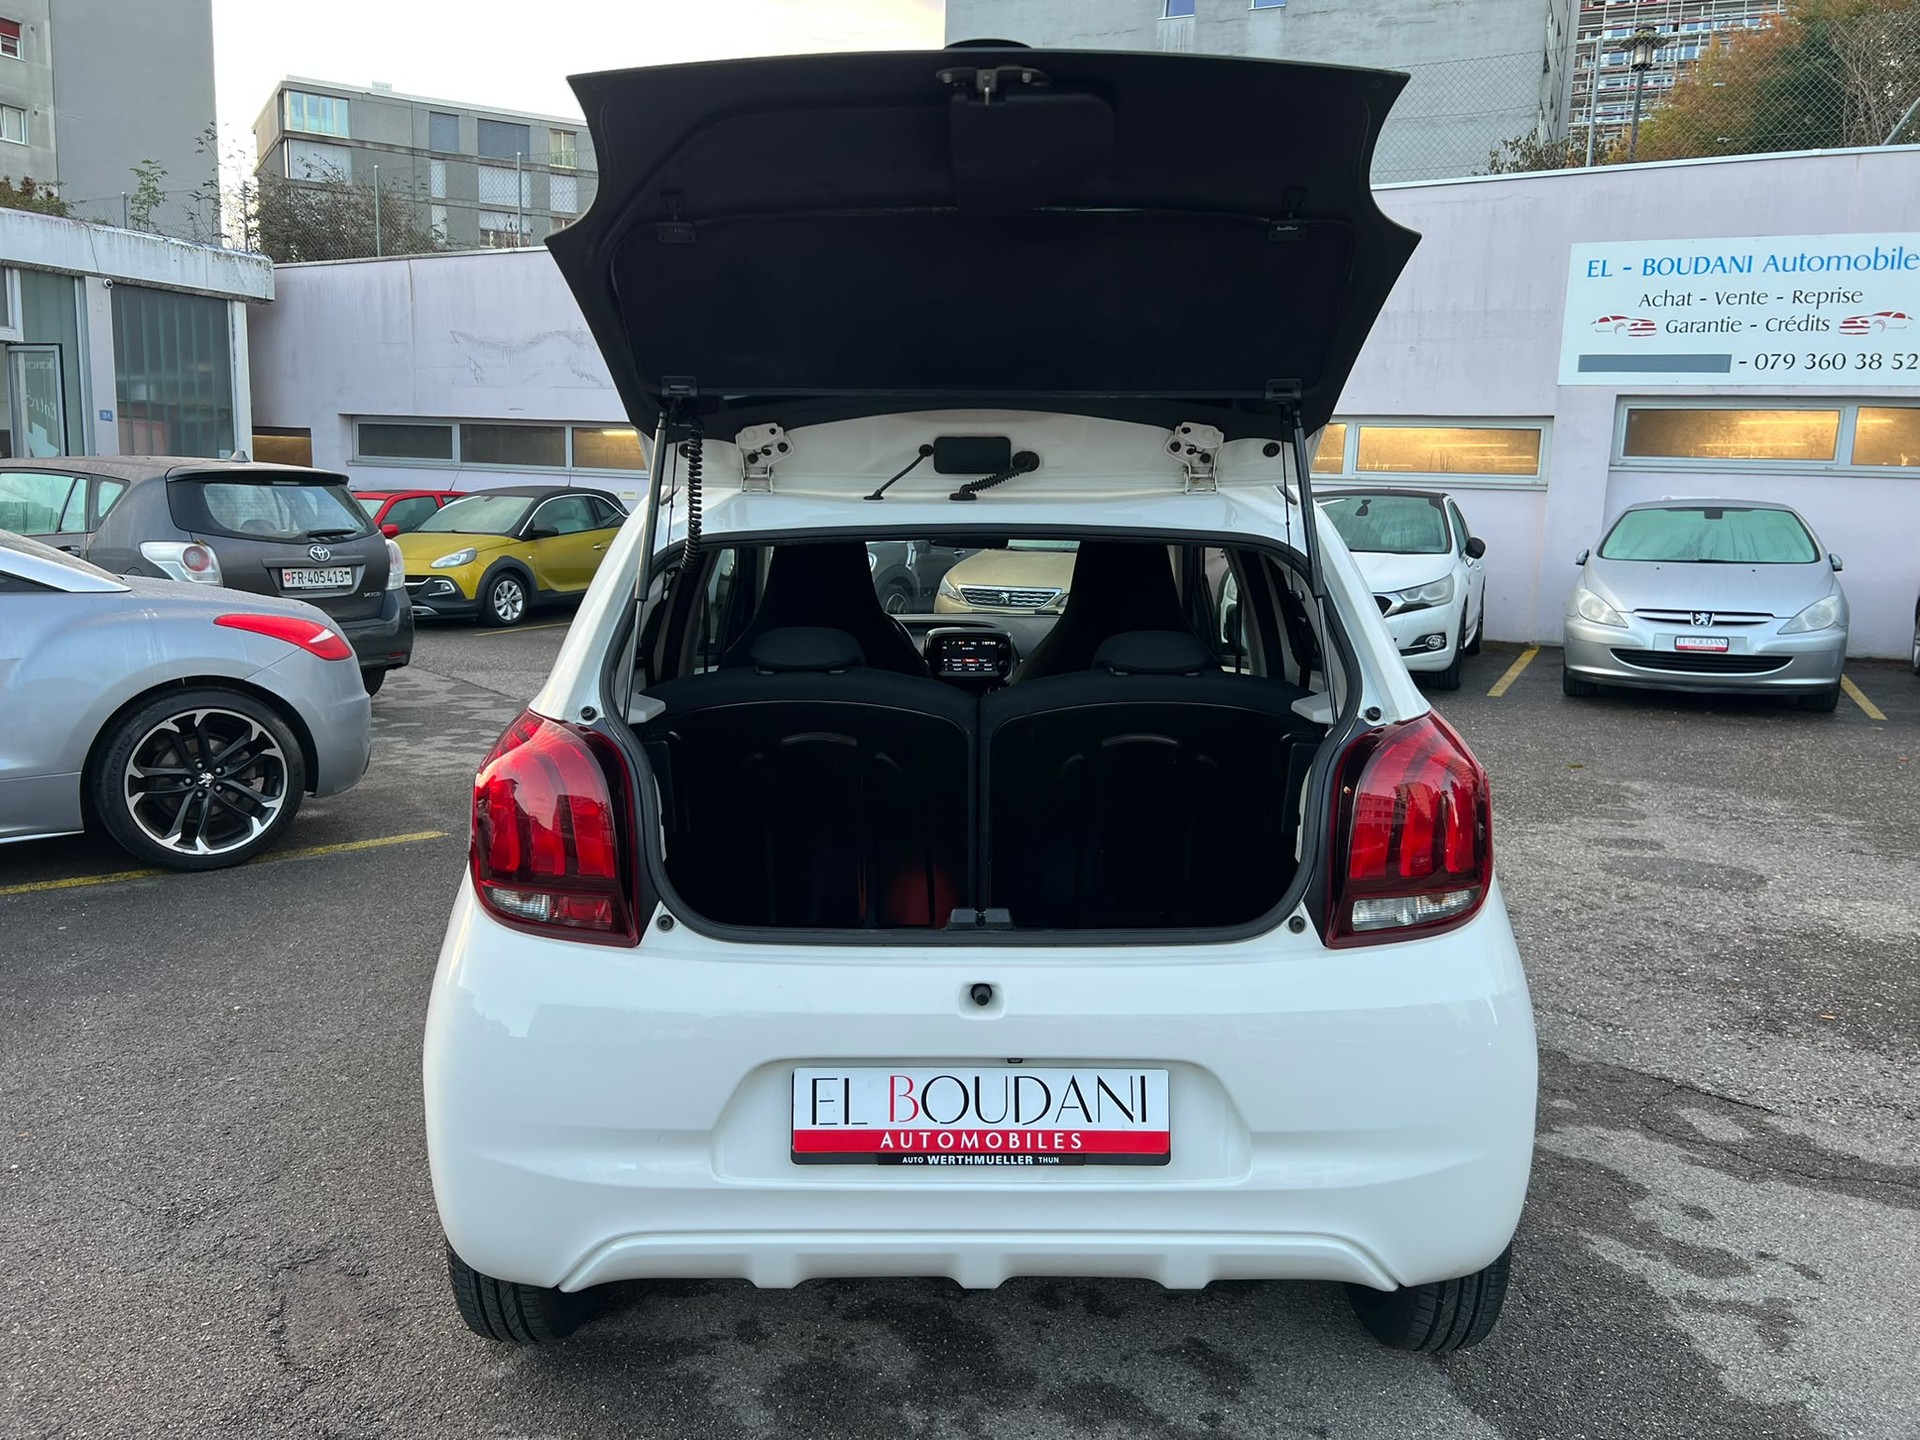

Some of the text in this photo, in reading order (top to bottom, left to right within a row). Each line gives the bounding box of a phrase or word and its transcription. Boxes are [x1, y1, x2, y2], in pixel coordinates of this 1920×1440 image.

[1587, 259, 1613, 278] EL
[1641, 255, 1753, 277] BOUDANI
[1762, 246, 1920, 274] Automobile
[1638, 289, 1693, 308] Achat
[1714, 290, 1769, 306] Vente
[1792, 287, 1863, 310] Reprise
[1665, 316, 1743, 334] Garantie
[1765, 314, 1830, 333] Crédits
[1754, 353, 1796, 371] 079
[1804, 353, 1846, 371] 360
[1854, 352, 1883, 370] 38
[1891, 352, 1919, 370] 52
[810, 1074, 1147, 1126] EL BOUDANI
[879, 1131, 1082, 1150] AUTOMOBILES
[902, 1154, 1060, 1166] AUTO WERTHMUELLER THUN
